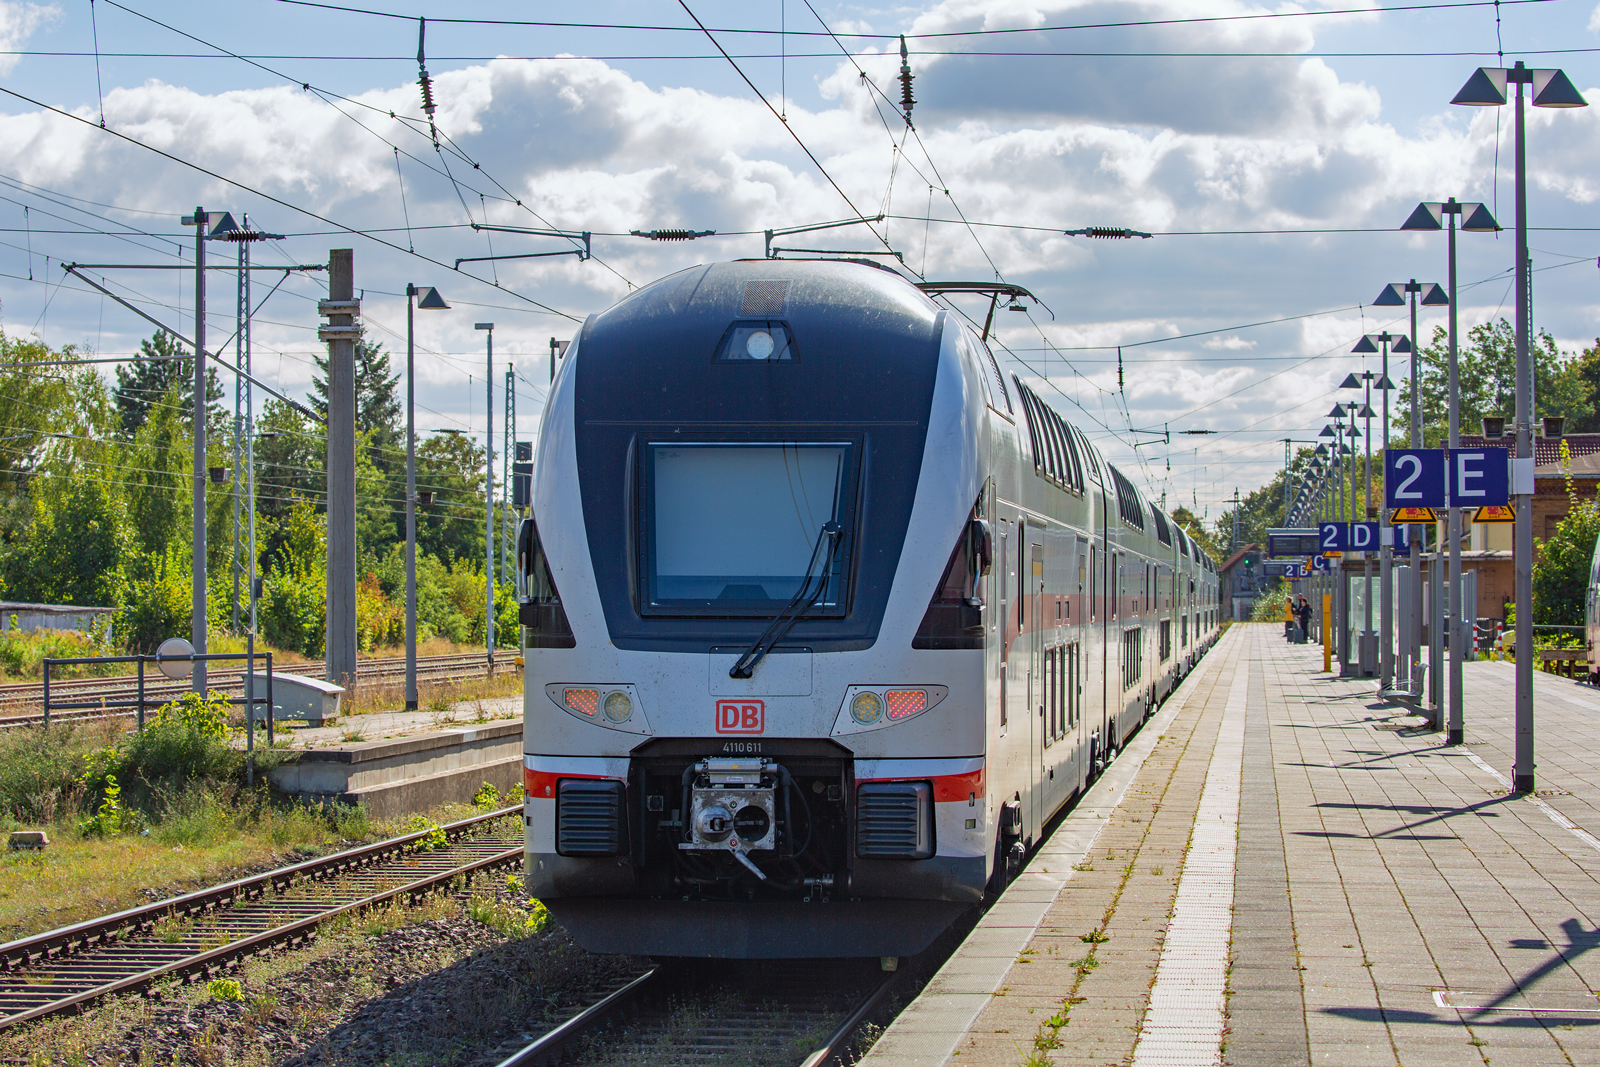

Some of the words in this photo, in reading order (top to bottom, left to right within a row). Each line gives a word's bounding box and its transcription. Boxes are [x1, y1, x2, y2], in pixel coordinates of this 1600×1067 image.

[1394, 454, 1423, 499] 2
[1458, 453, 1486, 497] E
[1323, 524, 1338, 548] 2
[1354, 524, 1371, 547] D
[1286, 565, 1294, 576] 2
[1300, 565, 1309, 576] B
[1313, 555, 1325, 569] C
[721, 705, 759, 729] DB
[723, 742, 745, 753] 4110
[746, 742, 762, 753] 611
